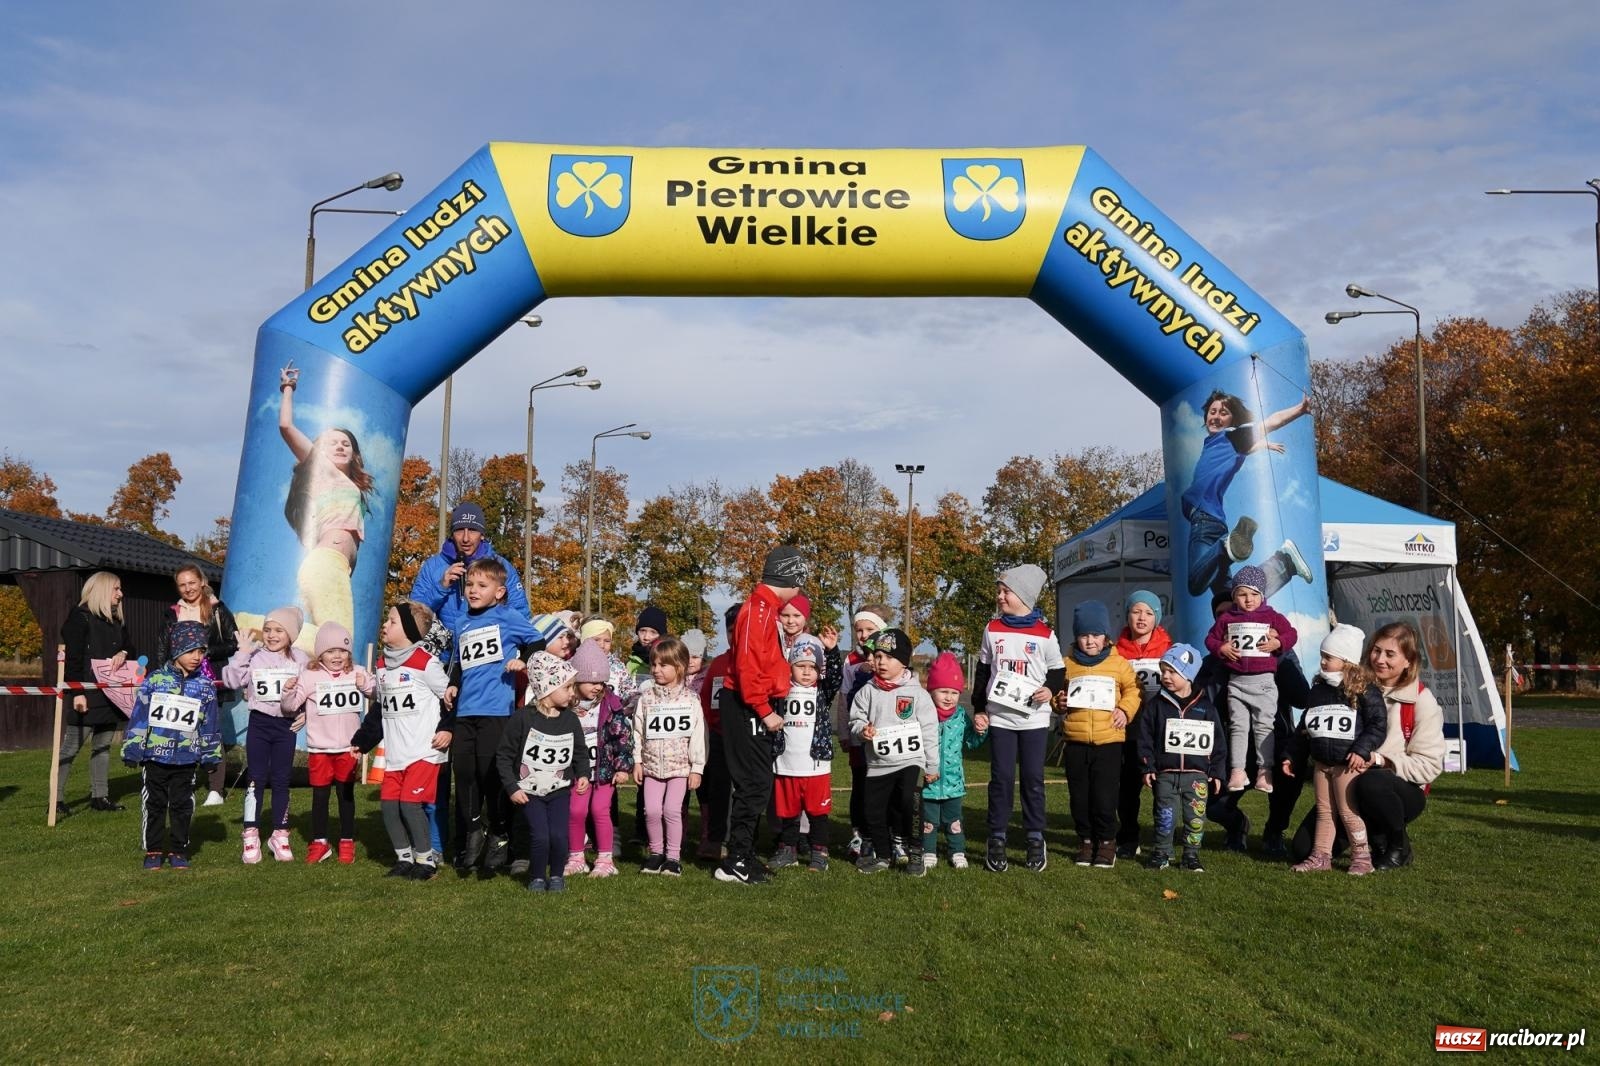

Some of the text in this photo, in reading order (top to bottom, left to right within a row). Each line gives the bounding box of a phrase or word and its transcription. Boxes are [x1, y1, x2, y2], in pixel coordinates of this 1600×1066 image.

[708, 156, 867, 175] Gmina
[666, 180, 911, 209] Pietrowice
[696, 215, 878, 246] Wielkie
[307, 179, 486, 324] Gmina ludzi
[1089, 186, 1263, 336] Gmina ludzi
[342, 213, 512, 354] aktywnych
[1063, 220, 1226, 364] aktywnych
[1144, 530, 1170, 549] Pe
[1404, 543, 1435, 553] MITKO
[462, 638, 498, 661] 425
[256, 680, 281, 695] 51
[1136, 671, 1161, 685] 21
[319, 691, 360, 708] 400
[383, 694, 415, 711] 414
[785, 700, 815, 715] 09
[151, 705, 195, 725] 404
[649, 715, 690, 732] 405
[1308, 716, 1352, 732] 419
[878, 735, 920, 756] 515
[1168, 731, 1210, 749] 520
[526, 745, 570, 764] 433
